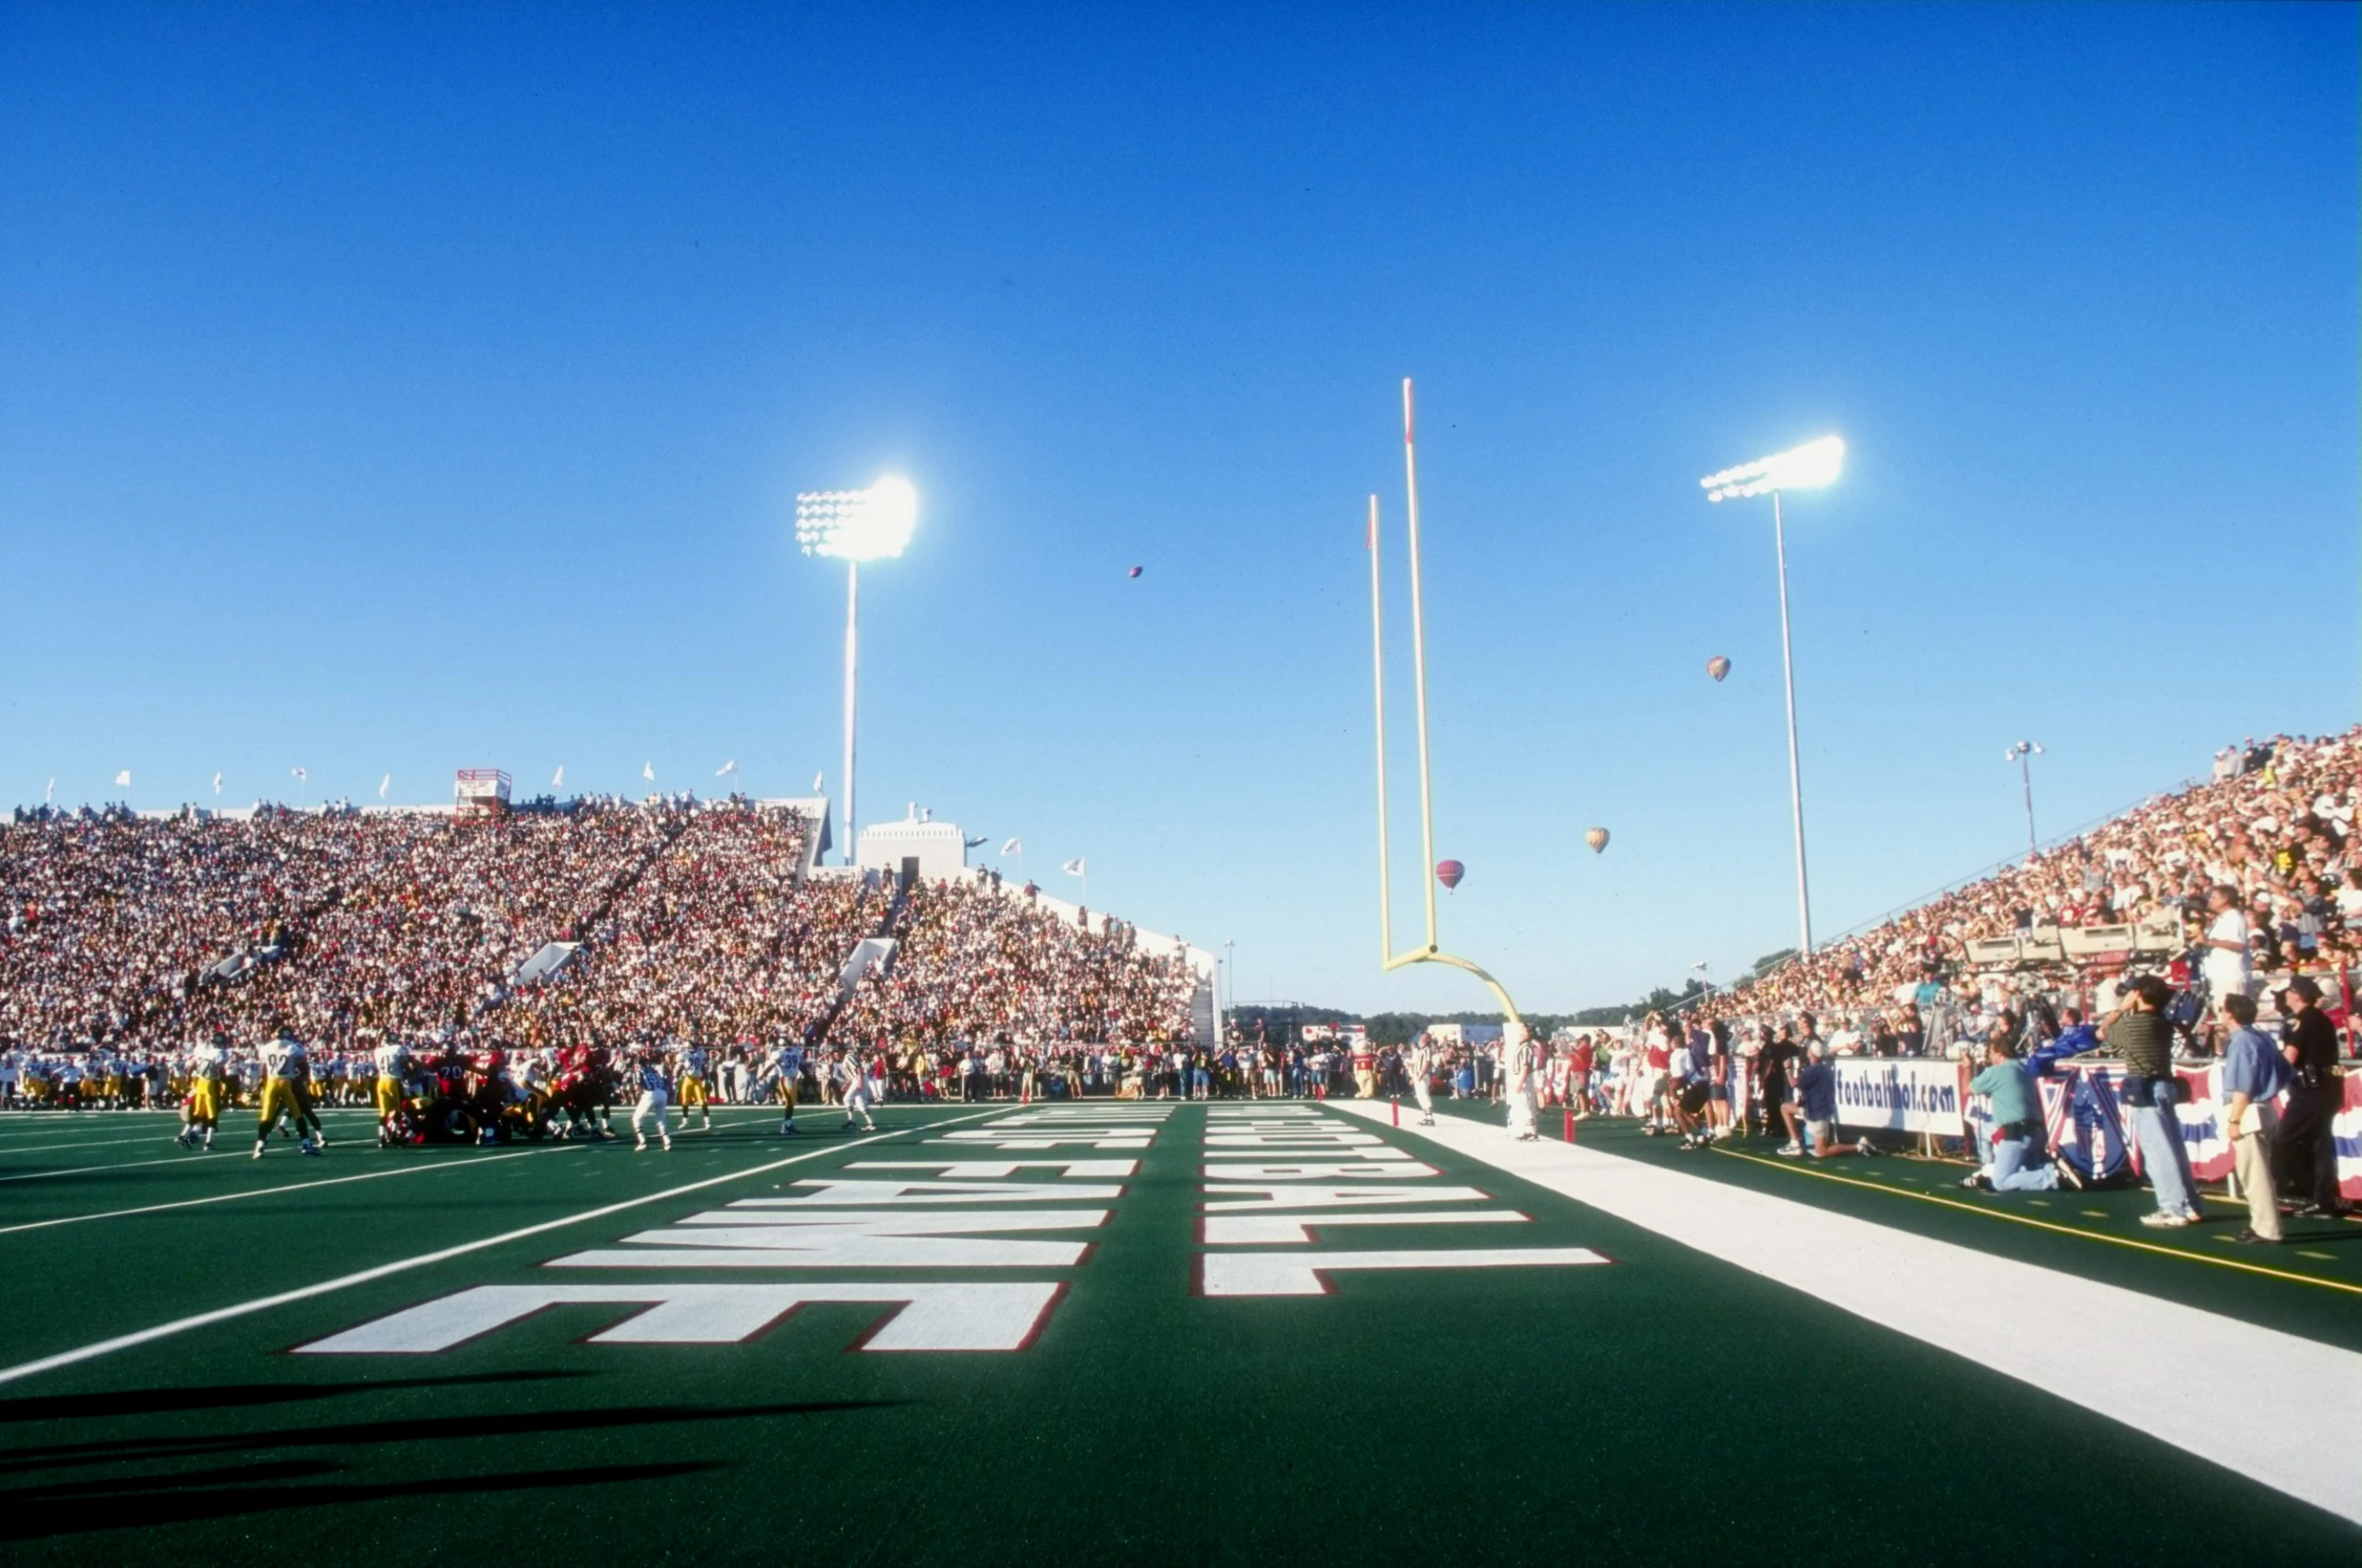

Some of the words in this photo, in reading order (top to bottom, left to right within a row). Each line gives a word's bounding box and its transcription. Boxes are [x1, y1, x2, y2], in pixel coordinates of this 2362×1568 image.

[268, 1054, 289, 1075] 92
[441, 1066, 461, 1079] 70
[785, 1054, 798, 1070] 39
[1837, 1069, 1955, 1113] footballhof.com
[982, 1105, 1176, 1126] HALL
[918, 1128, 1160, 1150] OF
[1192, 1119, 1614, 1296] FOOTBALL
[289, 1159, 1143, 1352] FAME
